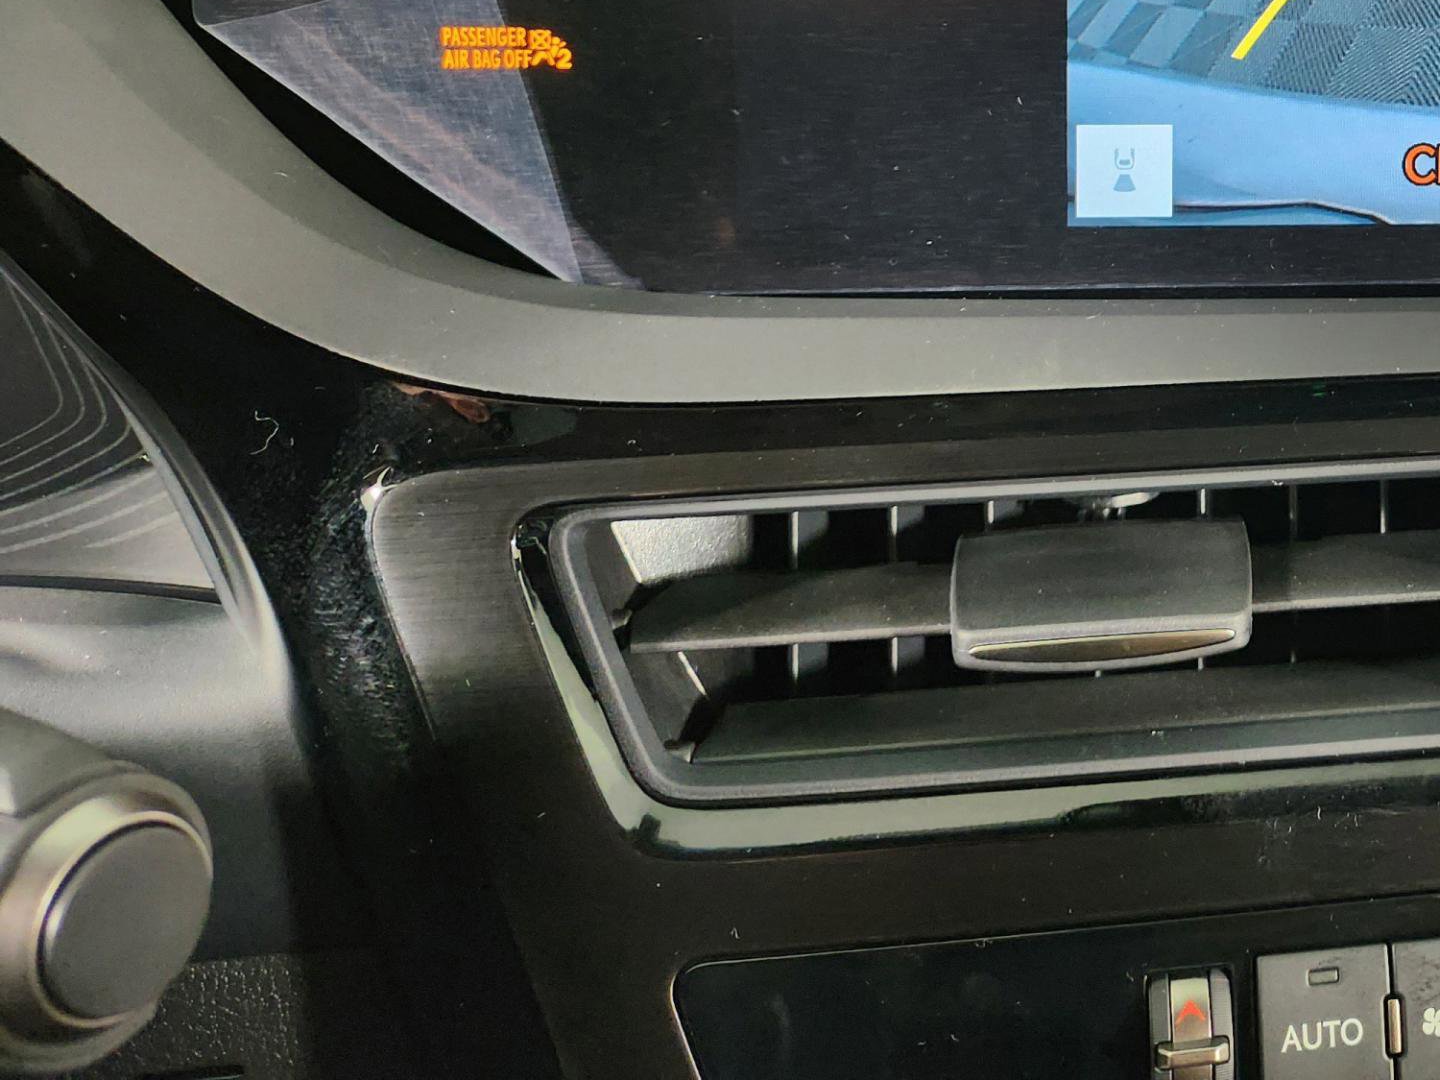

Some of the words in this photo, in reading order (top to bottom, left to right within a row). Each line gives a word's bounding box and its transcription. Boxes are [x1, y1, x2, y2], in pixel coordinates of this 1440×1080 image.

[440, 26, 527, 47] PASSENGER
[442, 49, 470, 69] AIR
[472, 49, 501, 69] BAG
[503, 49, 532, 69] OFF
[1280, 1017, 1364, 1053] AUTO
